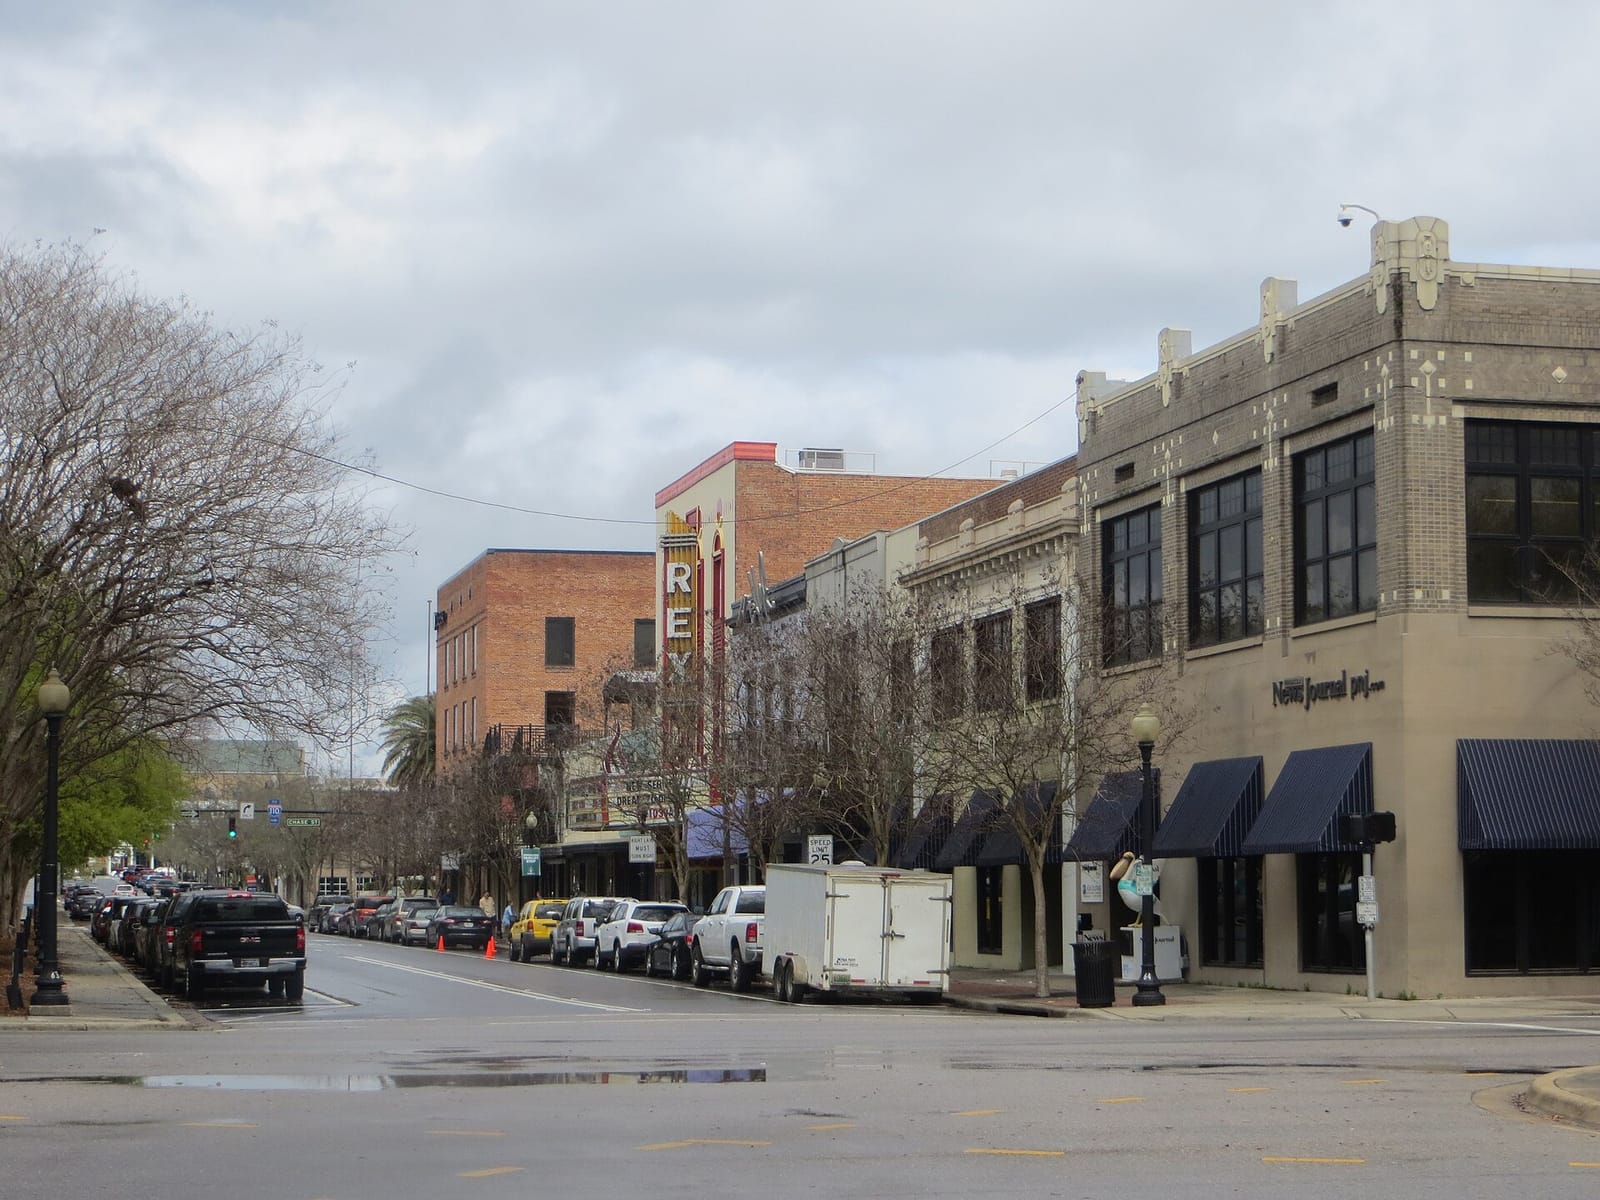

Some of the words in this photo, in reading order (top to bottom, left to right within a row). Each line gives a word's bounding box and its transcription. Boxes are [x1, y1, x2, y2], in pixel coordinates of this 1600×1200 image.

[1272, 680, 1305, 707] News
[269, 807, 280, 815] 110
[811, 854, 830, 865] 25
